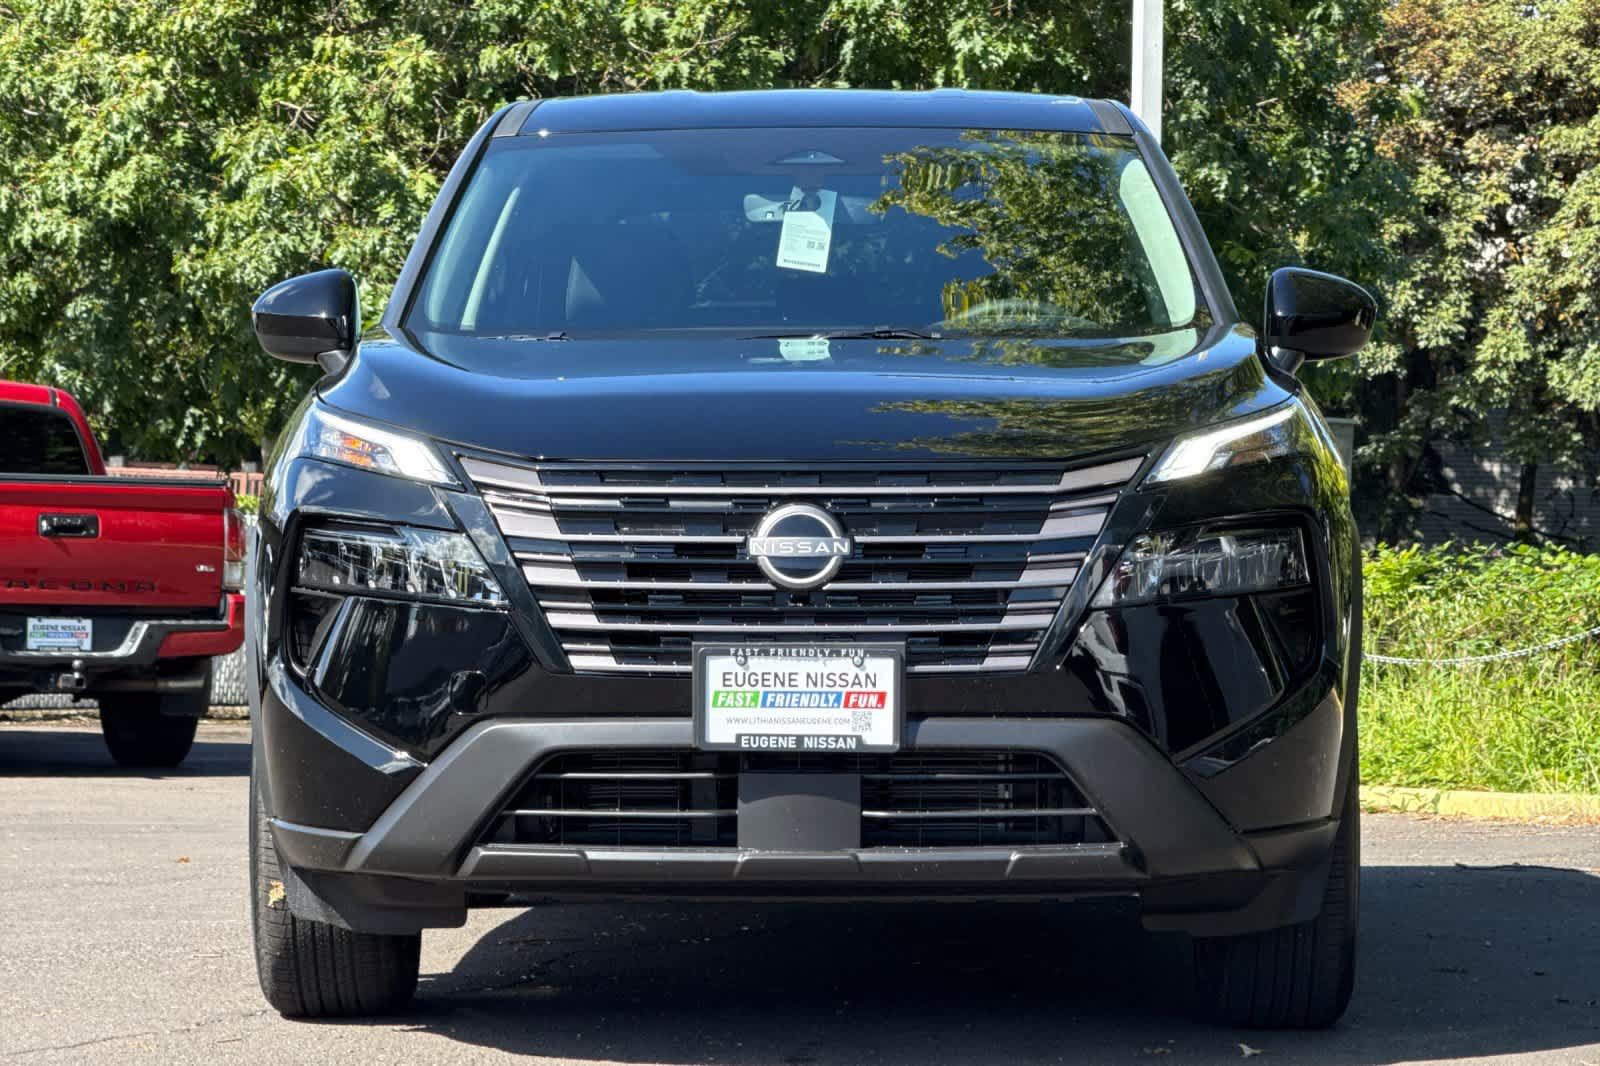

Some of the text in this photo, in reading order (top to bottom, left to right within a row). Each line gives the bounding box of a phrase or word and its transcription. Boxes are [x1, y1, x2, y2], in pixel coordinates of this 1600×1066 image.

[752, 542, 849, 553] NISSAN
[4, 578, 156, 591] ACOMA
[730, 648, 870, 657] FAST. FRIENDLY. FUN.
[722, 672, 877, 688] EUGENE NISSAN
[717, 692, 882, 708] FAST. FRIENDLY. FUN.
[726, 717, 851, 726] WWW.LITHIANISSANEUGENE.COM
[741, 736, 857, 749] EUGENE NISSAN
